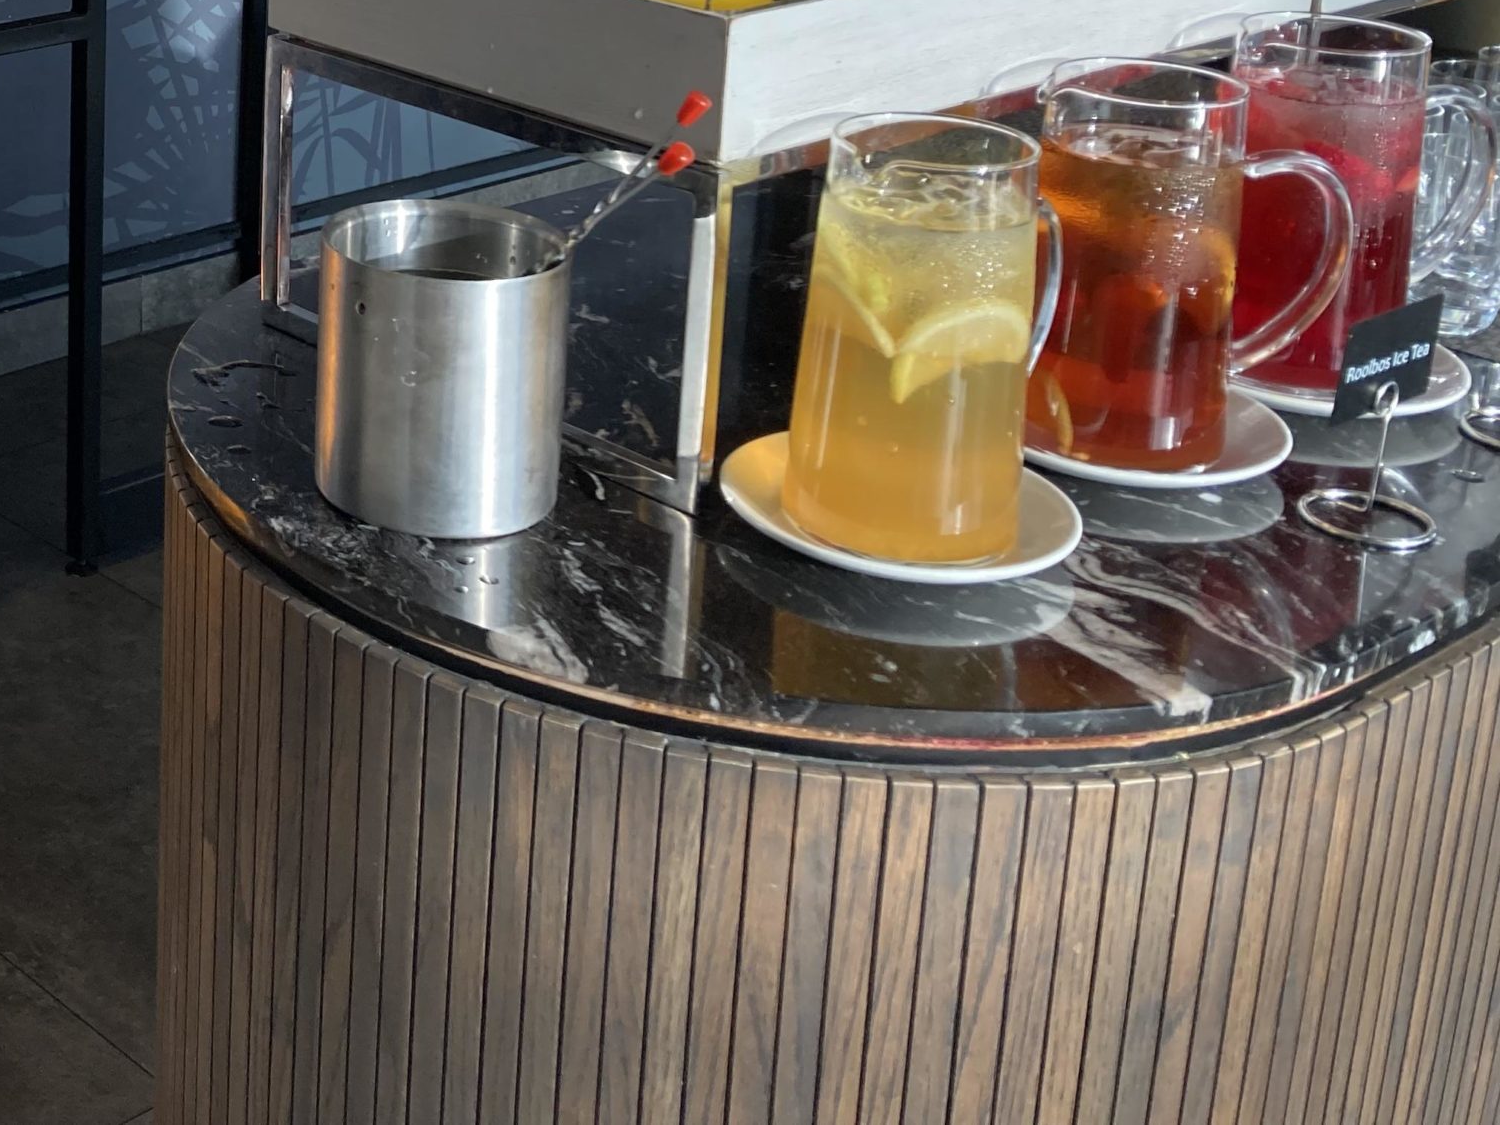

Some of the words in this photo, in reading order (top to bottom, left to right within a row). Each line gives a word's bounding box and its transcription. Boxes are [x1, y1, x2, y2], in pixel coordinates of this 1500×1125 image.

[1346, 357, 1392, 383] Rooibos
[1392, 350, 1409, 366] Ice
[1411, 343, 1431, 359] Tea
